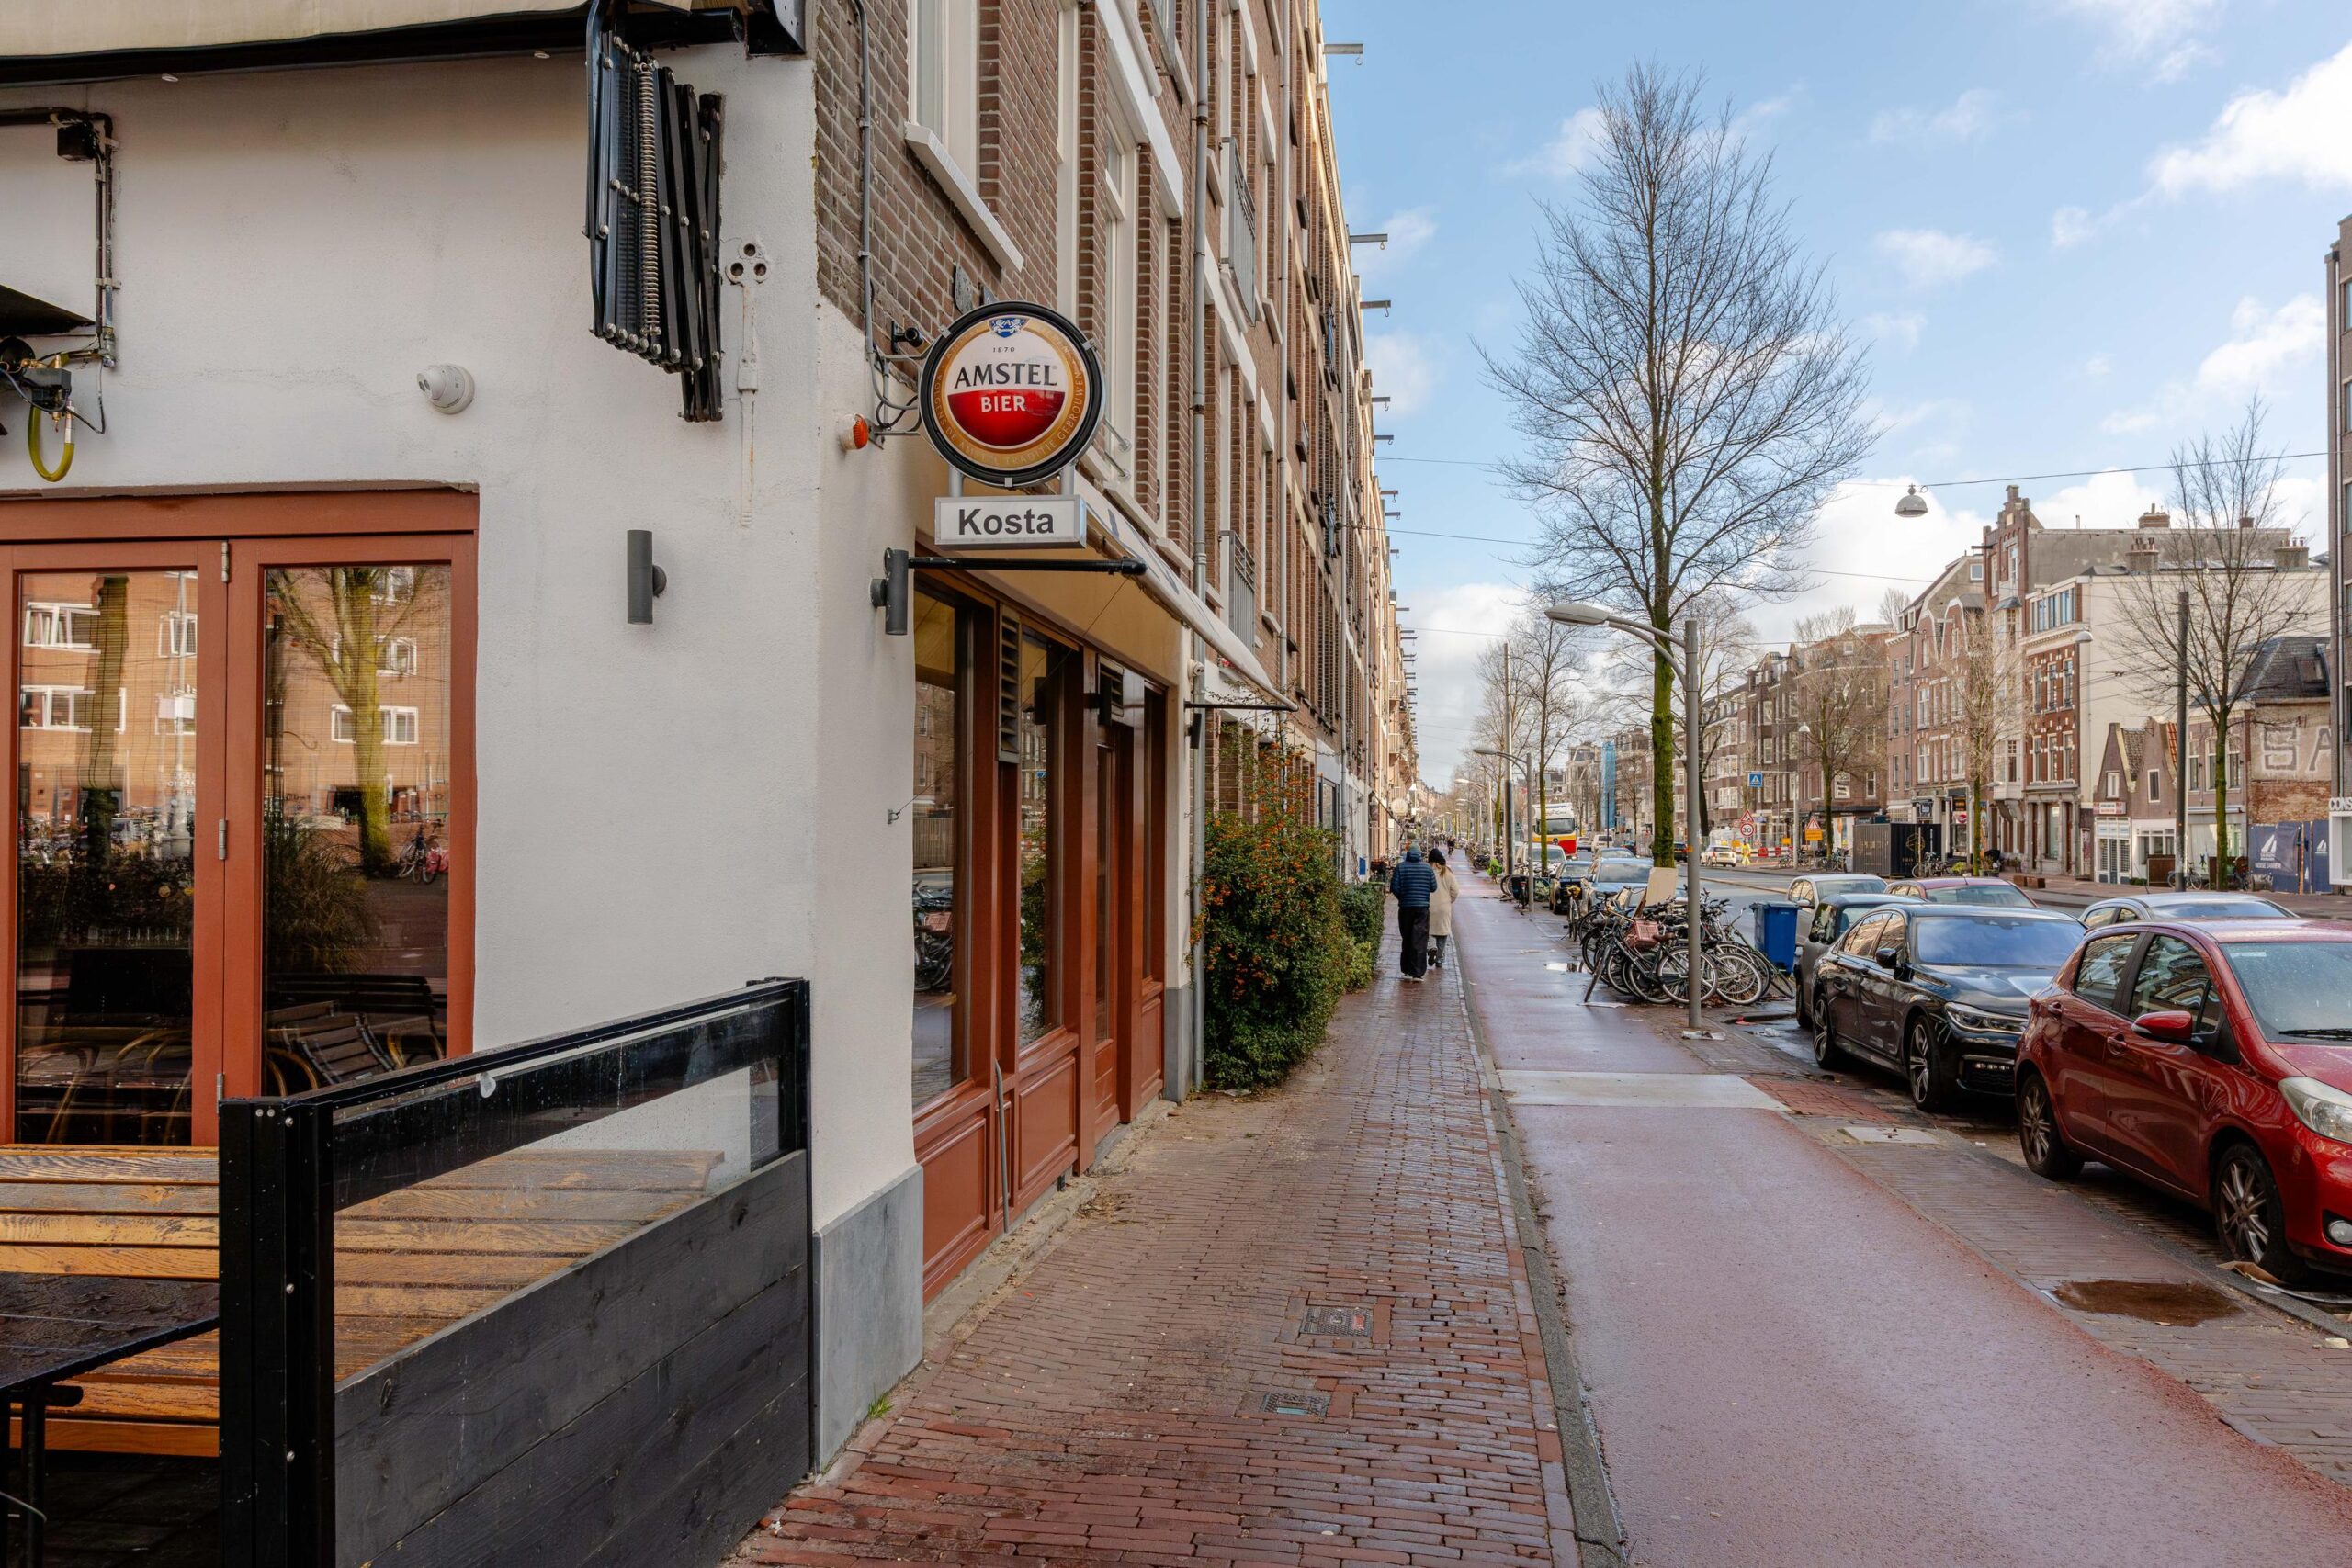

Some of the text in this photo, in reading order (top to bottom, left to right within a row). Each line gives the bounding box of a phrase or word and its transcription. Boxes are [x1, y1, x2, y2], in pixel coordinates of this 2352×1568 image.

[954, 362, 1057, 389] AMSTEL
[933, 374, 947, 425] VOLGENS
[945, 426, 957, 442] DE
[1057, 370, 1085, 440] GEBROUWEN
[980, 395, 1026, 412] BIER
[958, 508, 1054, 535] Kosta
